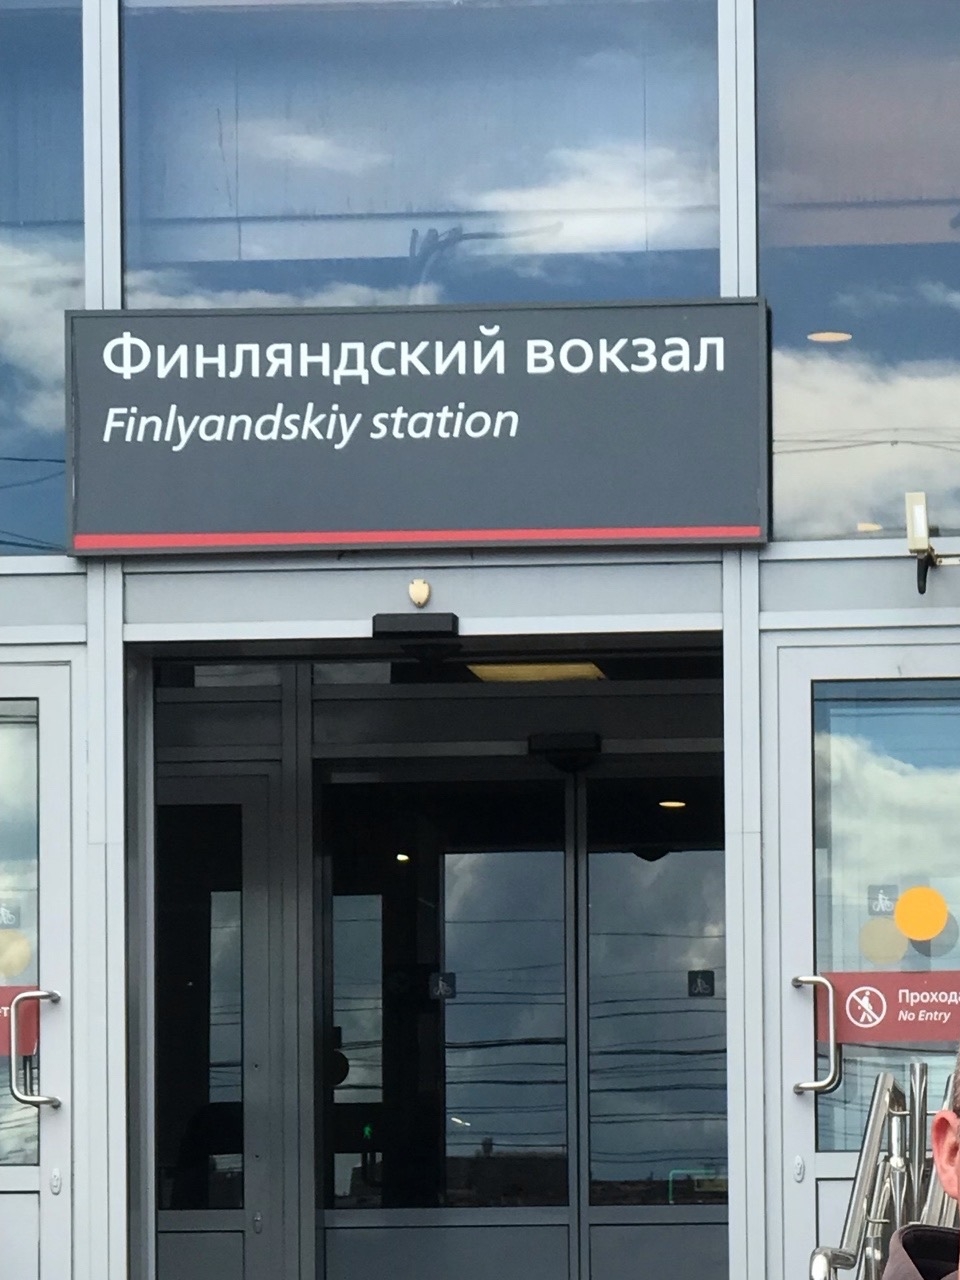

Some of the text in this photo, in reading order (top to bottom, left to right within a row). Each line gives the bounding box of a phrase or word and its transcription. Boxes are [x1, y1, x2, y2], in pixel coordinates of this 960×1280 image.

[102, 325, 726, 386] Финляндский вокзал
[102, 402, 519, 452] Finlyandskiy station
[898, 1010, 951, 1023] No Entry
